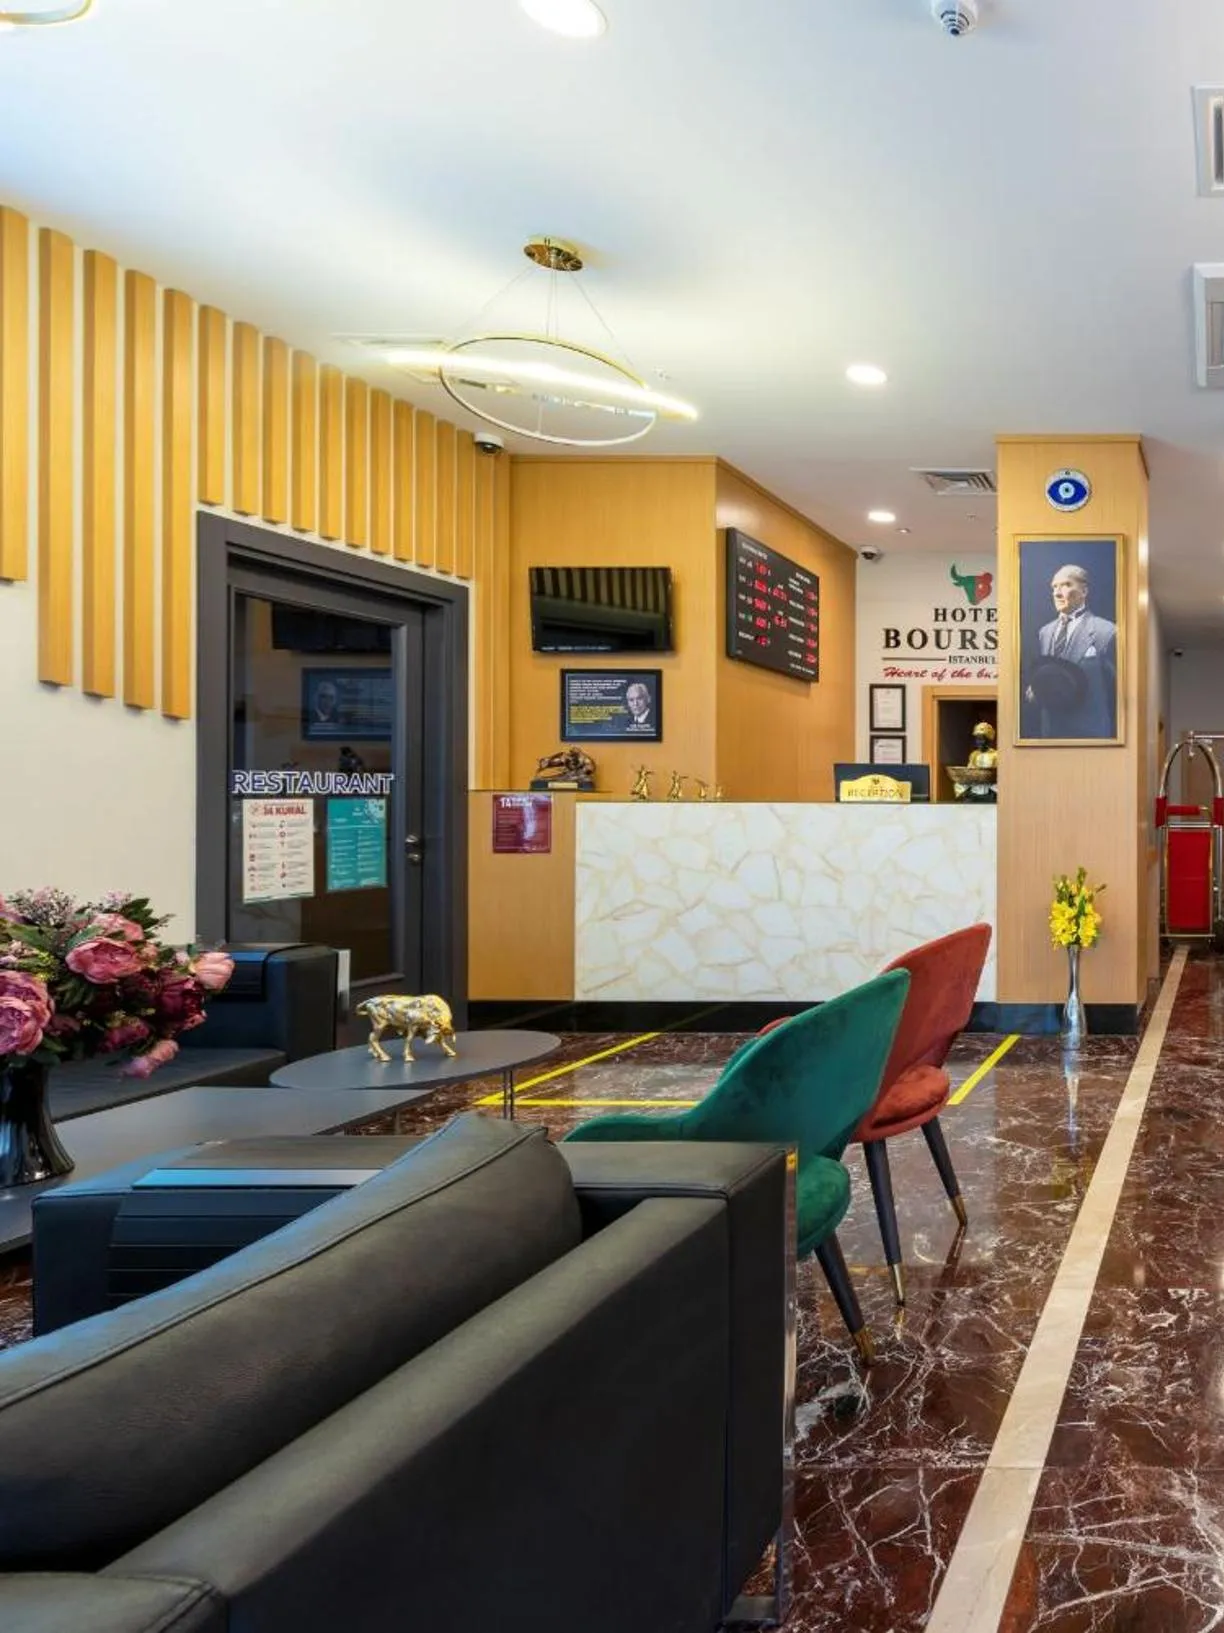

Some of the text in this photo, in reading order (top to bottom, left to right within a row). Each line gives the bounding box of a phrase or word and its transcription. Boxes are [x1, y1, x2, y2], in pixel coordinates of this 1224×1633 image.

[933, 607, 998, 623] HOTE
[883, 627, 998, 651] BOURS
[931, 668, 947, 681] of
[950, 667, 973, 679] the
[231, 770, 395, 794] RESTAURANT
[847, 786, 905, 799] RECEPTION
